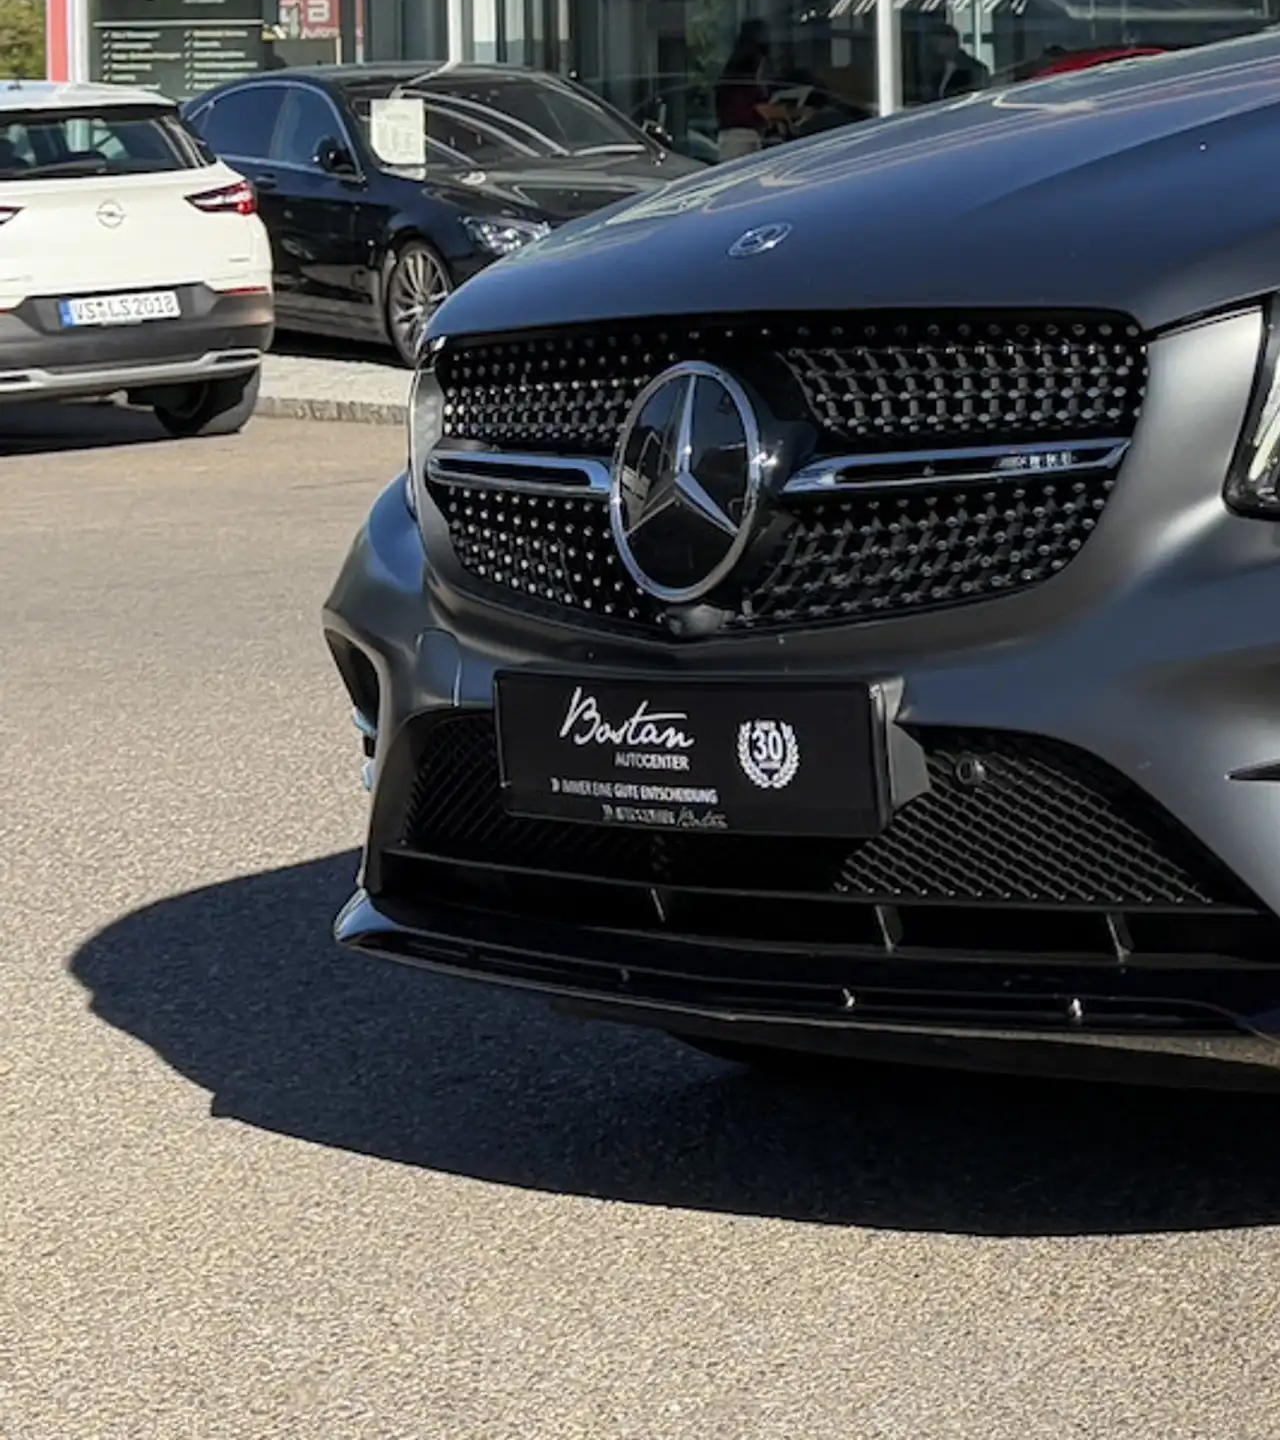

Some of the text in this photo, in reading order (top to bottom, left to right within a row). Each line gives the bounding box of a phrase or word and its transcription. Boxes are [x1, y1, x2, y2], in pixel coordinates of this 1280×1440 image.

[559, 686, 695, 748] Bostan
[752, 728, 783, 760] 30
[614, 751, 690, 771] AUTOCENTER
